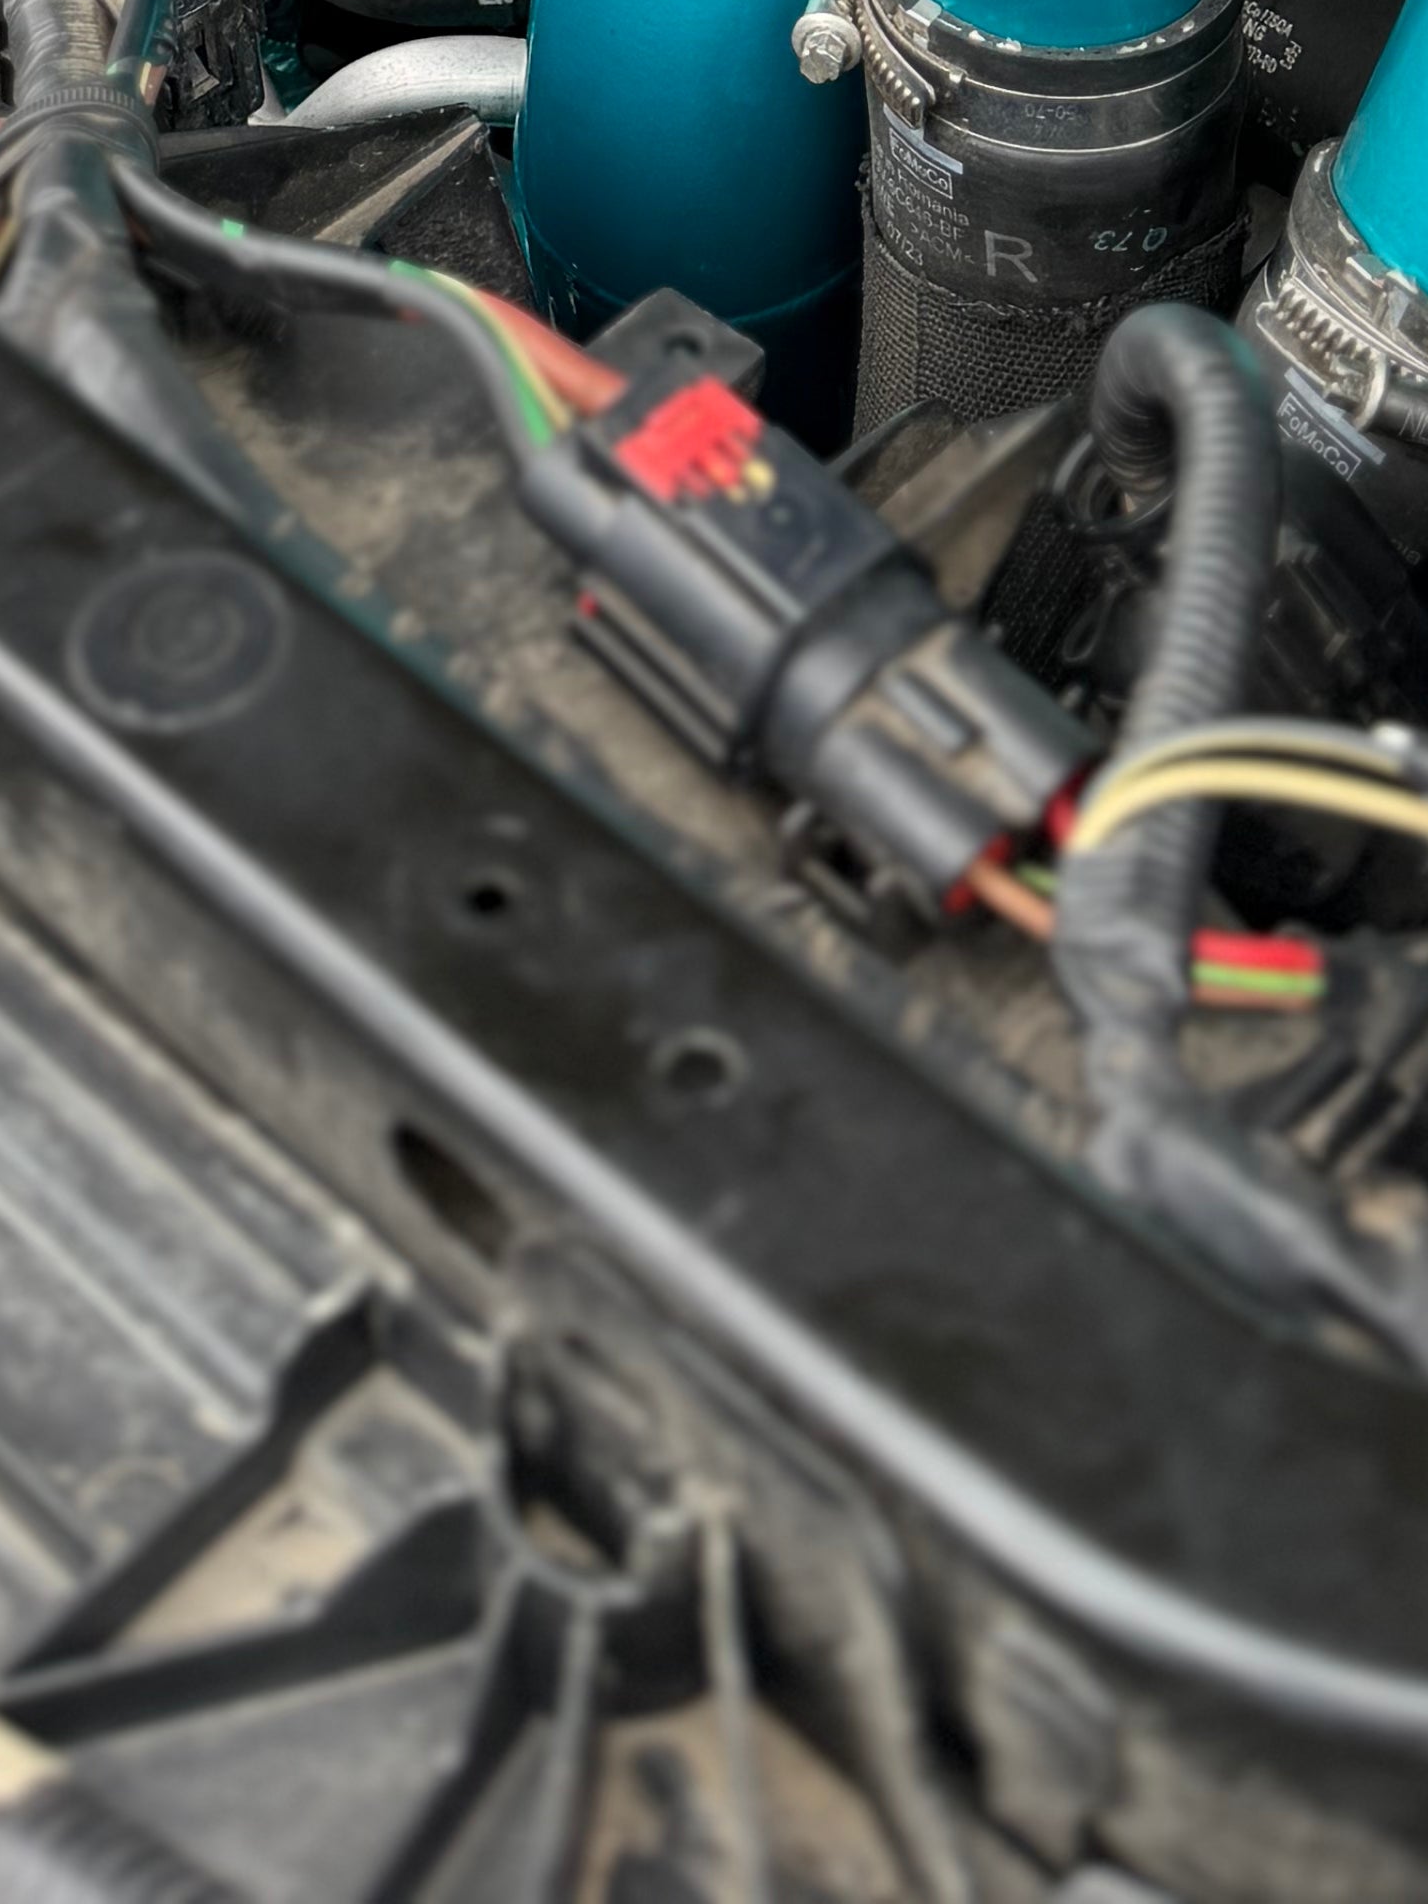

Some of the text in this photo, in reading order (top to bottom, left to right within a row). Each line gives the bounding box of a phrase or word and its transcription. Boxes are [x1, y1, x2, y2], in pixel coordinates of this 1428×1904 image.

[891, 142, 949, 191] FoMoCo
[984, 230, 1039, 283] R
[1280, 401, 1350, 476] FoMoCo
